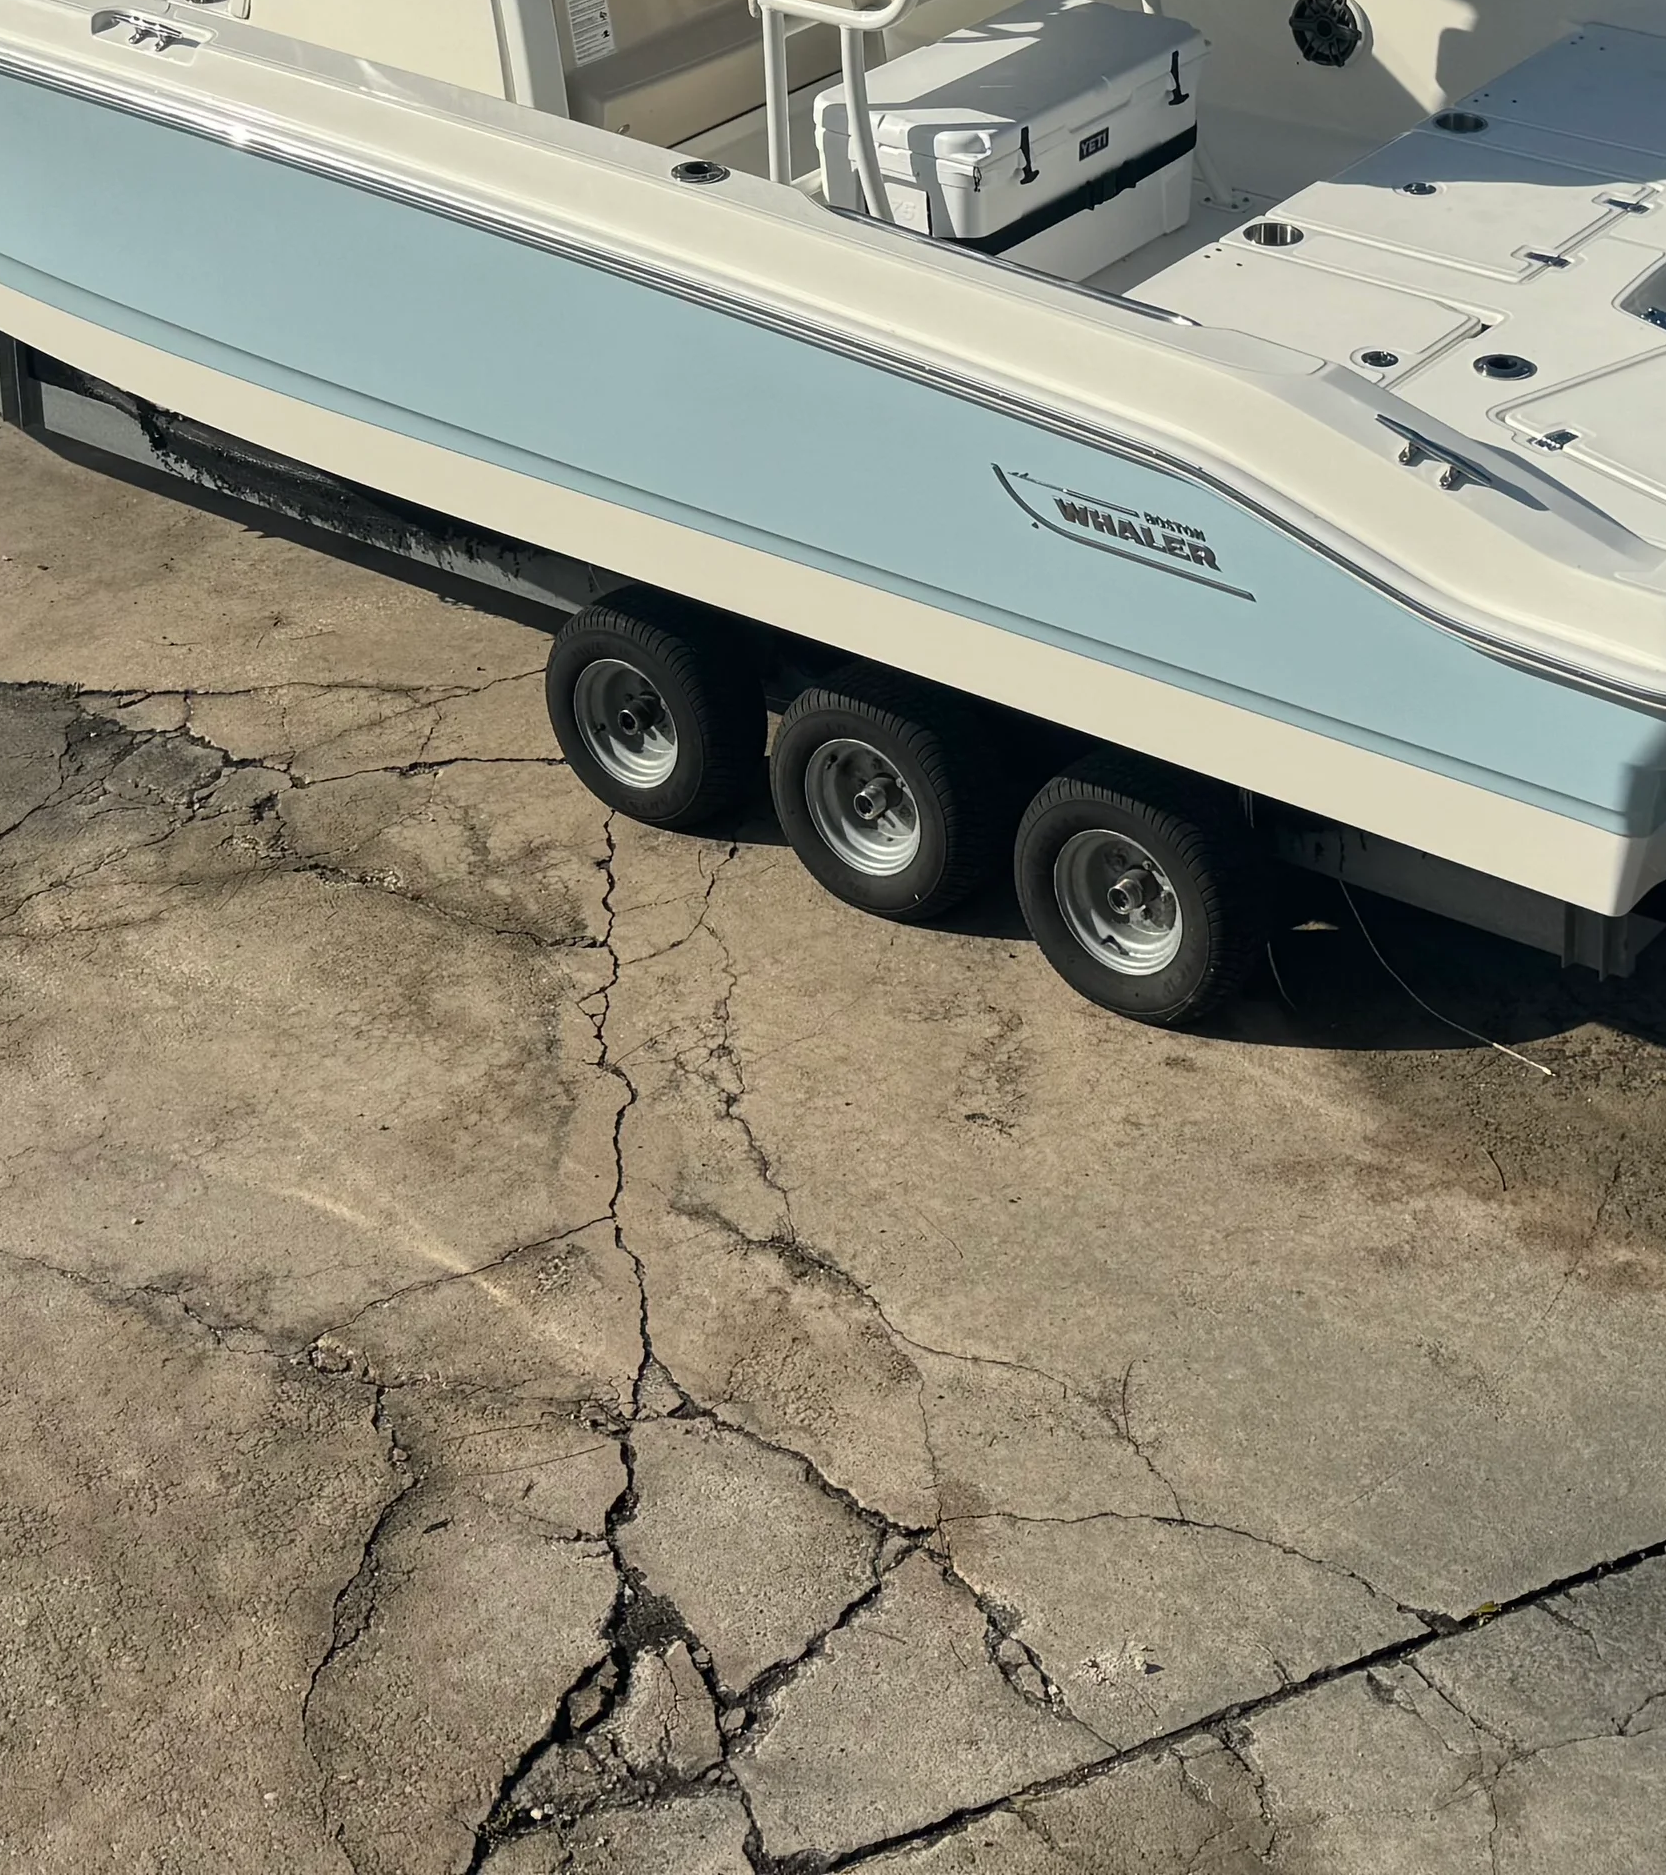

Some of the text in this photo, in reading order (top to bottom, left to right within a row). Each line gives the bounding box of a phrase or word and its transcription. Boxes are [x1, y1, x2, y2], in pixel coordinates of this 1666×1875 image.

[1081, 131, 1107, 156] YETI
[1052, 495, 1223, 573] WHALER
[1143, 511, 1206, 542] BOSTON
